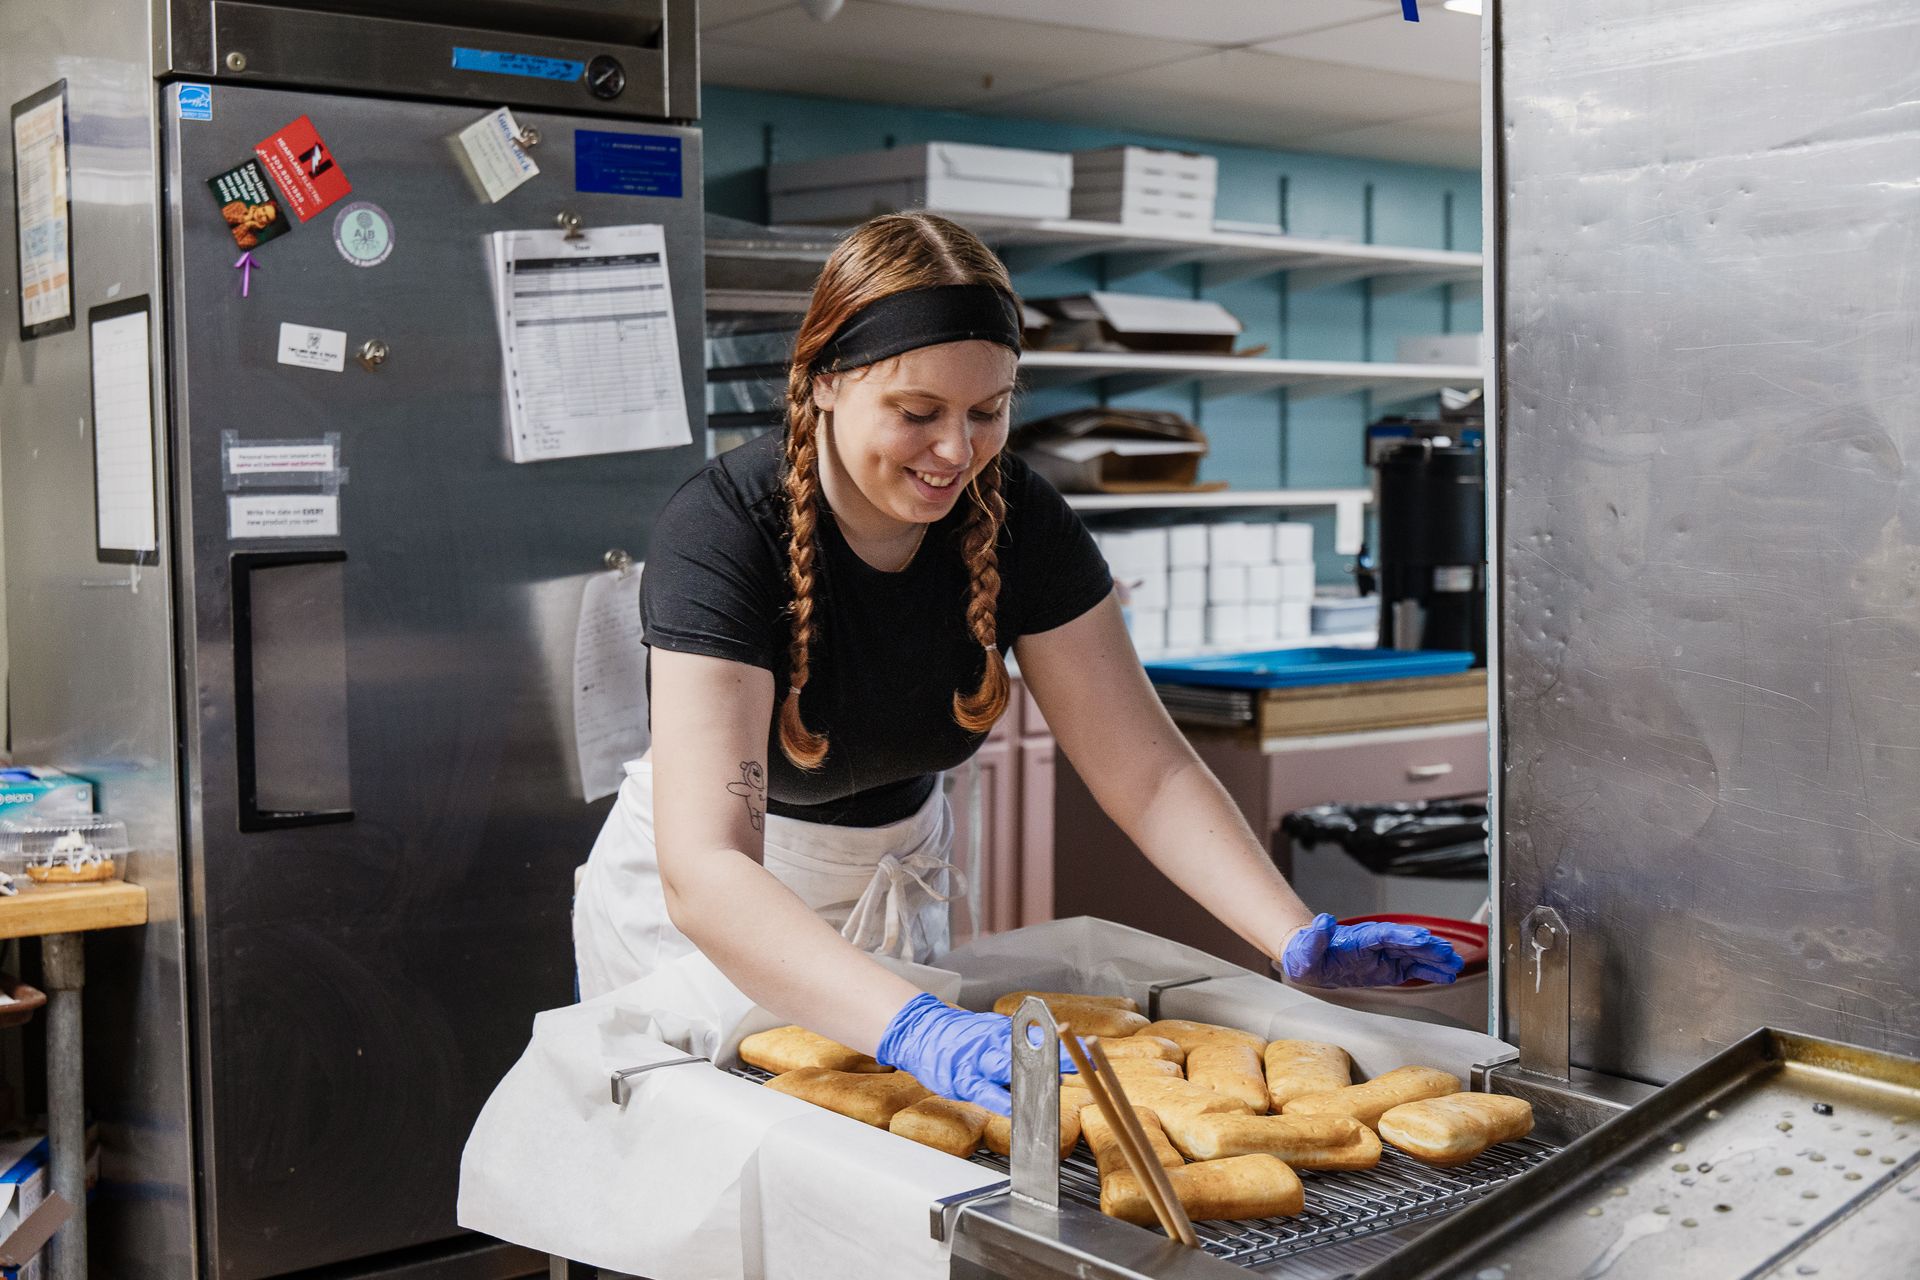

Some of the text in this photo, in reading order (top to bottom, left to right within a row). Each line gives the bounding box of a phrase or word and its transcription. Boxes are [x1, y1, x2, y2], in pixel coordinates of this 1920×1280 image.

[277, 137, 322, 204] HEARTLAND ELECTRIC
[250, 191, 261, 204] you
[256, 181, 269, 202] listen
[302, 507, 324, 516] EVERY
